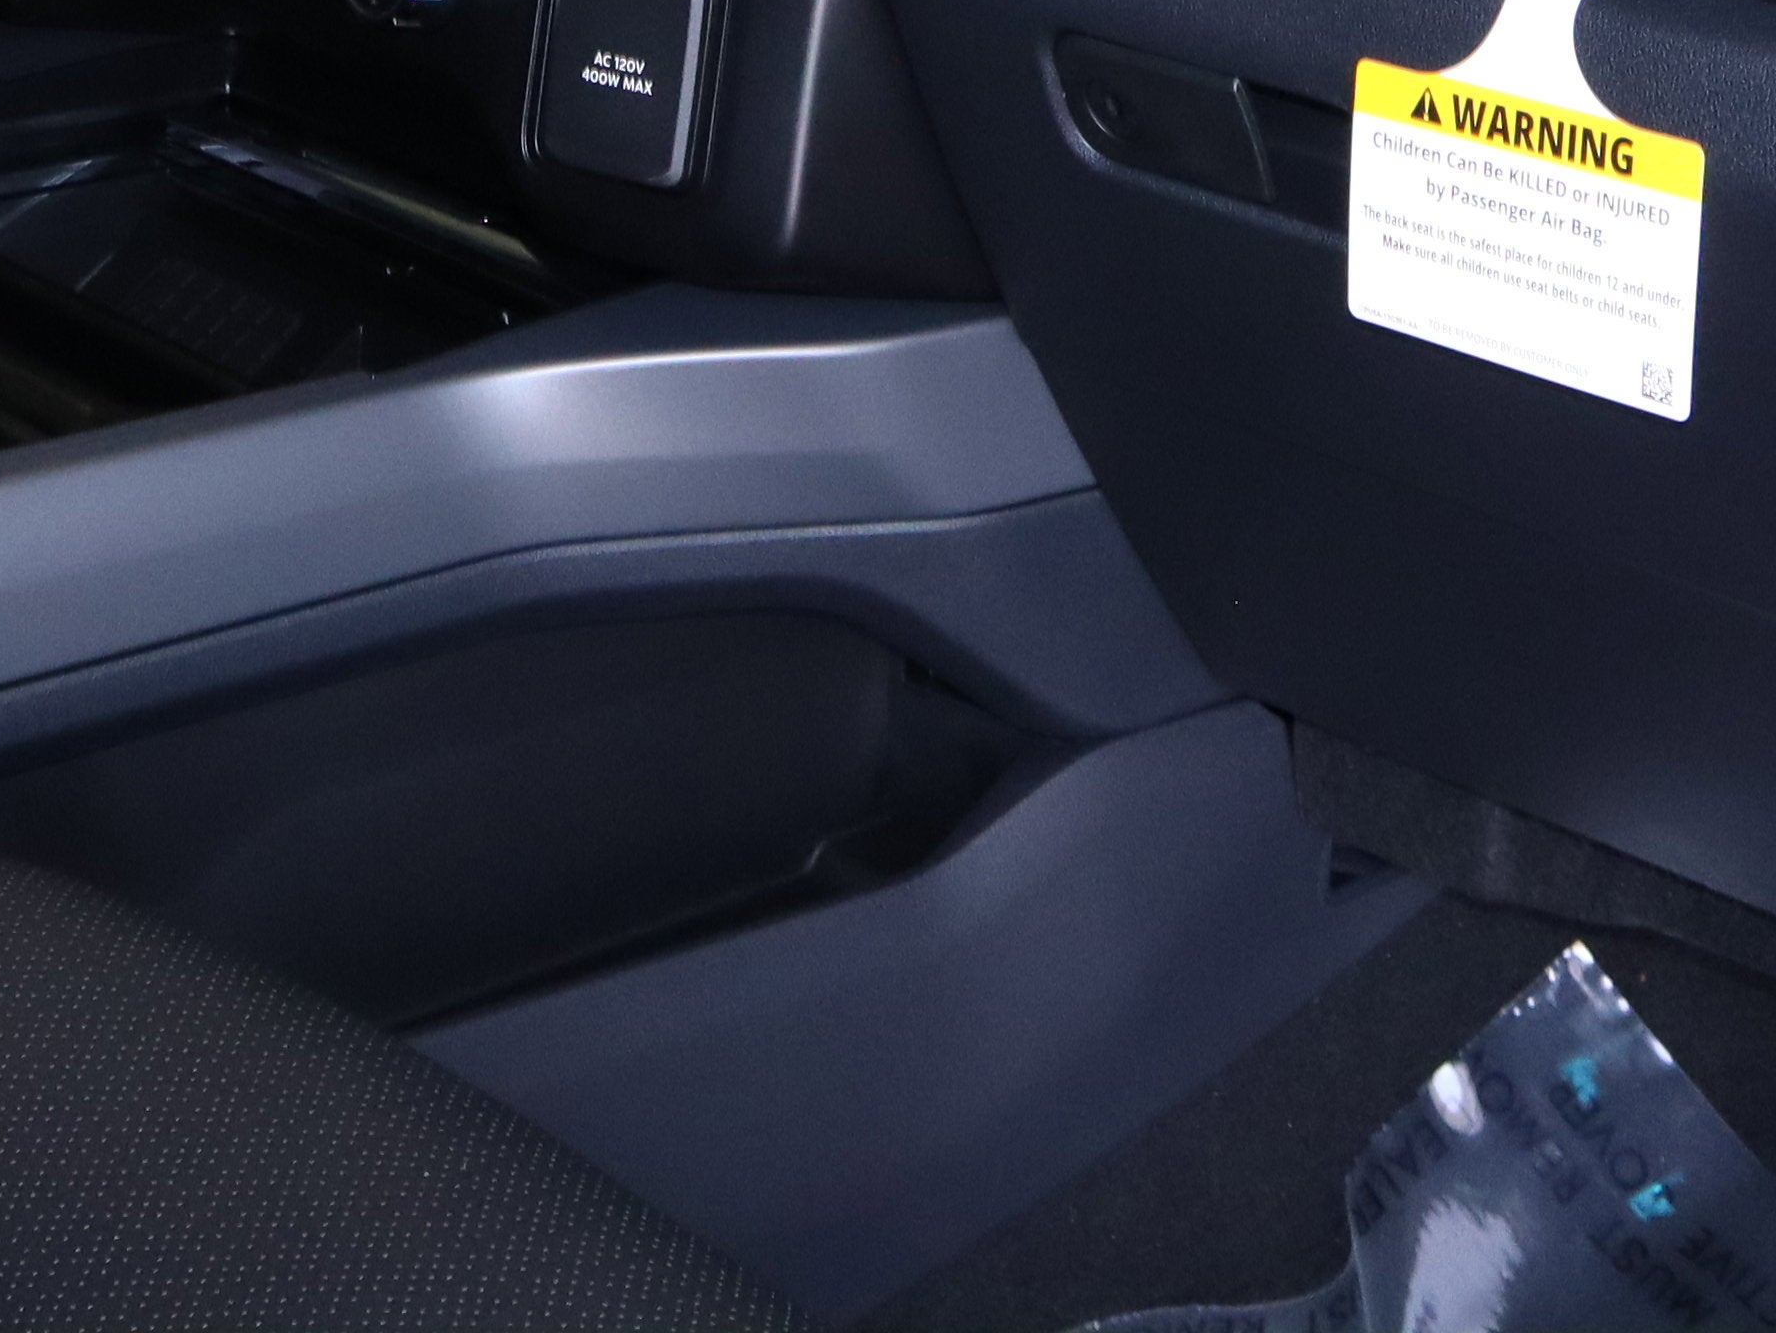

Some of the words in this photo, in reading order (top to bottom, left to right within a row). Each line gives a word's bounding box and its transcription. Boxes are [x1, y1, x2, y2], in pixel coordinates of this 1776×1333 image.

[581, 66, 620, 88] 400W
[622, 72, 653, 96] MAX
[594, 51, 612, 69] AC
[614, 57, 645, 75] 120V
[1452, 93, 1635, 177] WARNING
[1372, 131, 1441, 165] Children
[1446, 151, 1478, 175] Can
[1483, 161, 1504, 181] Be
[1509, 168, 1567, 199] KILLED
[1572, 187, 1591, 205] or
[1596, 191, 1671, 227] INJURED
[1426, 178, 1446, 202] by
[1450, 186, 1536, 223] Passenger
[1541, 211, 1566, 232] Air
[1571, 218, 1608, 247] Bag.
[1363, 205, 1382, 222] The
[1384, 210, 1409, 231] back
[1411, 220, 1434, 238] seat
[1436, 225, 1446, 241] is
[1449, 230, 1467, 247] the
[1470, 234, 1502, 258] safest
[1505, 245, 1534, 267] place
[1537, 255, 1553, 271] for
[1556, 259, 1602, 287] children
[1607, 275, 1619, 291] 12
[1622, 280, 1644, 299] and
[1647, 287, 1685, 311] under.
[1382, 234, 1412, 255] Make
[1414, 244, 1438, 263] sure
[1440, 250, 1454, 267] all
[1456, 254, 1501, 282] children
[1503, 271, 1522, 289] use
[1525, 276, 1549, 296] seat
[1552, 284, 1579, 305] belts
[1582, 293, 1595, 308] or
[1597, 296, 1625, 318] child
[1628, 307, 1662, 329] seats.
